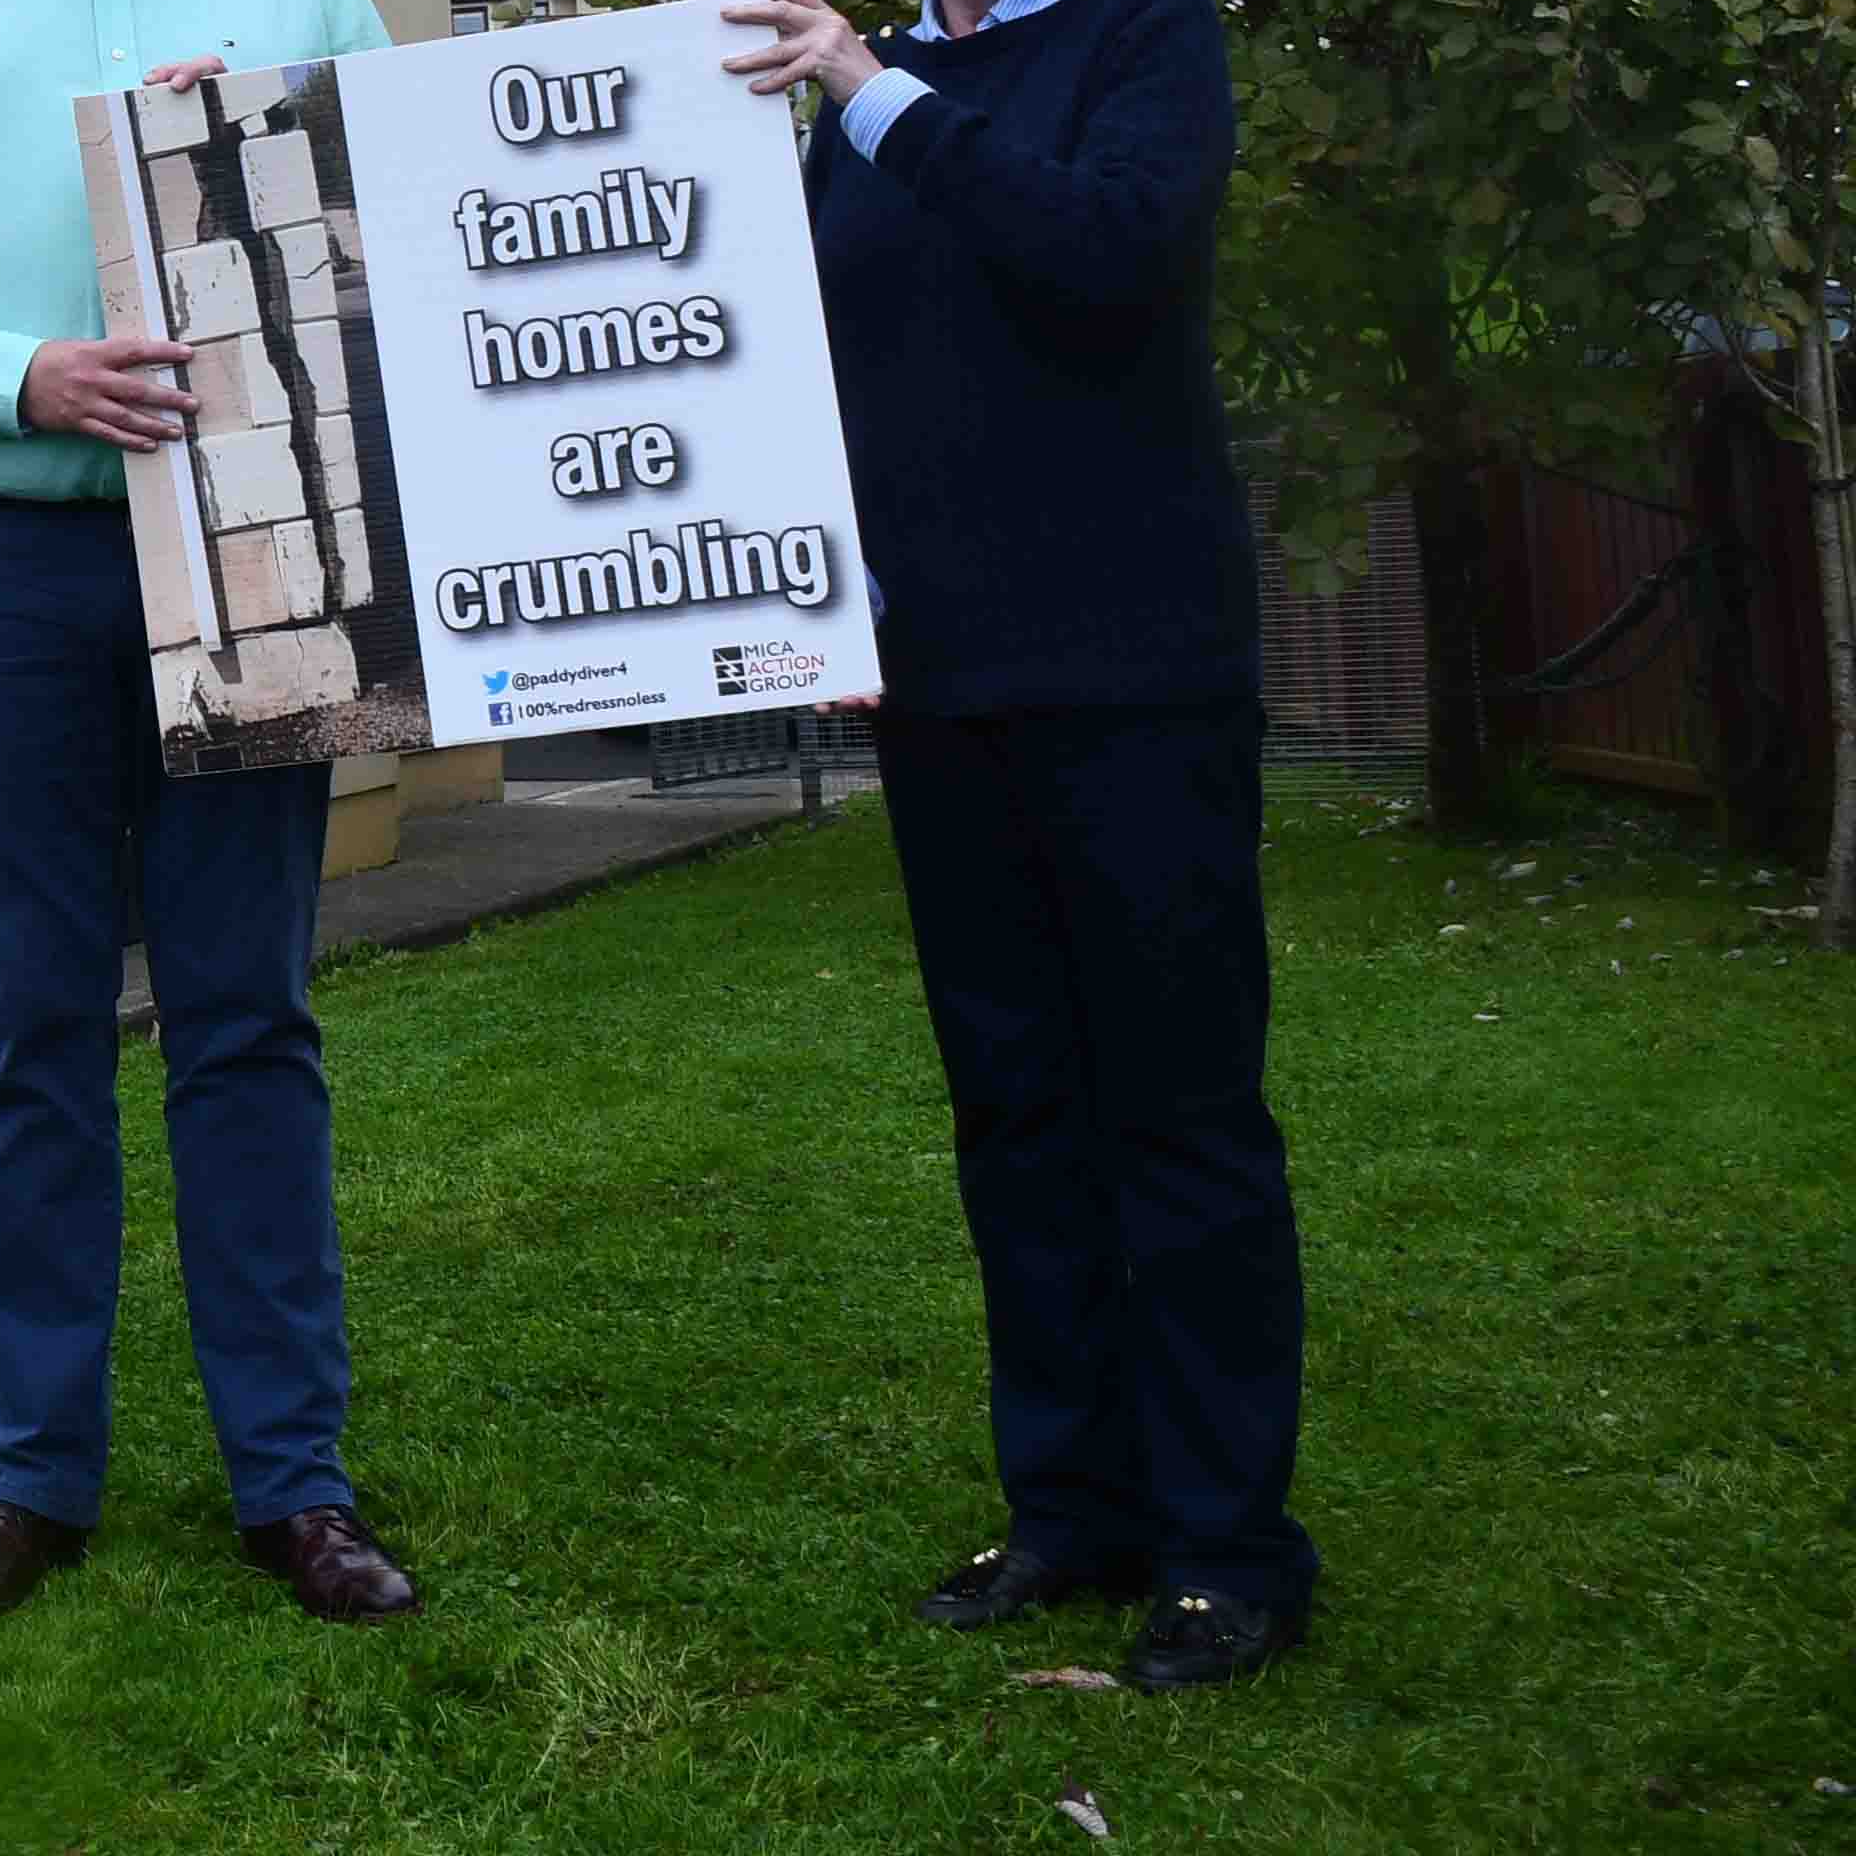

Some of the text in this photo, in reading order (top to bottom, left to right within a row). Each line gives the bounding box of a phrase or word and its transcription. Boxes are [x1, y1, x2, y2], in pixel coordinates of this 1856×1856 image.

[490, 64, 625, 144] Our
[452, 166, 695, 270] family
[464, 295, 726, 389] homes
[551, 422, 676, 498] are
[436, 519, 830, 632] crumbling
[512, 661, 627, 691] @paddydiver4
[744, 641, 794, 658] MICA
[748, 655, 824, 675] ACTION
[518, 692, 666, 719] 100%redressnoless
[750, 672, 819, 692] GROUP
